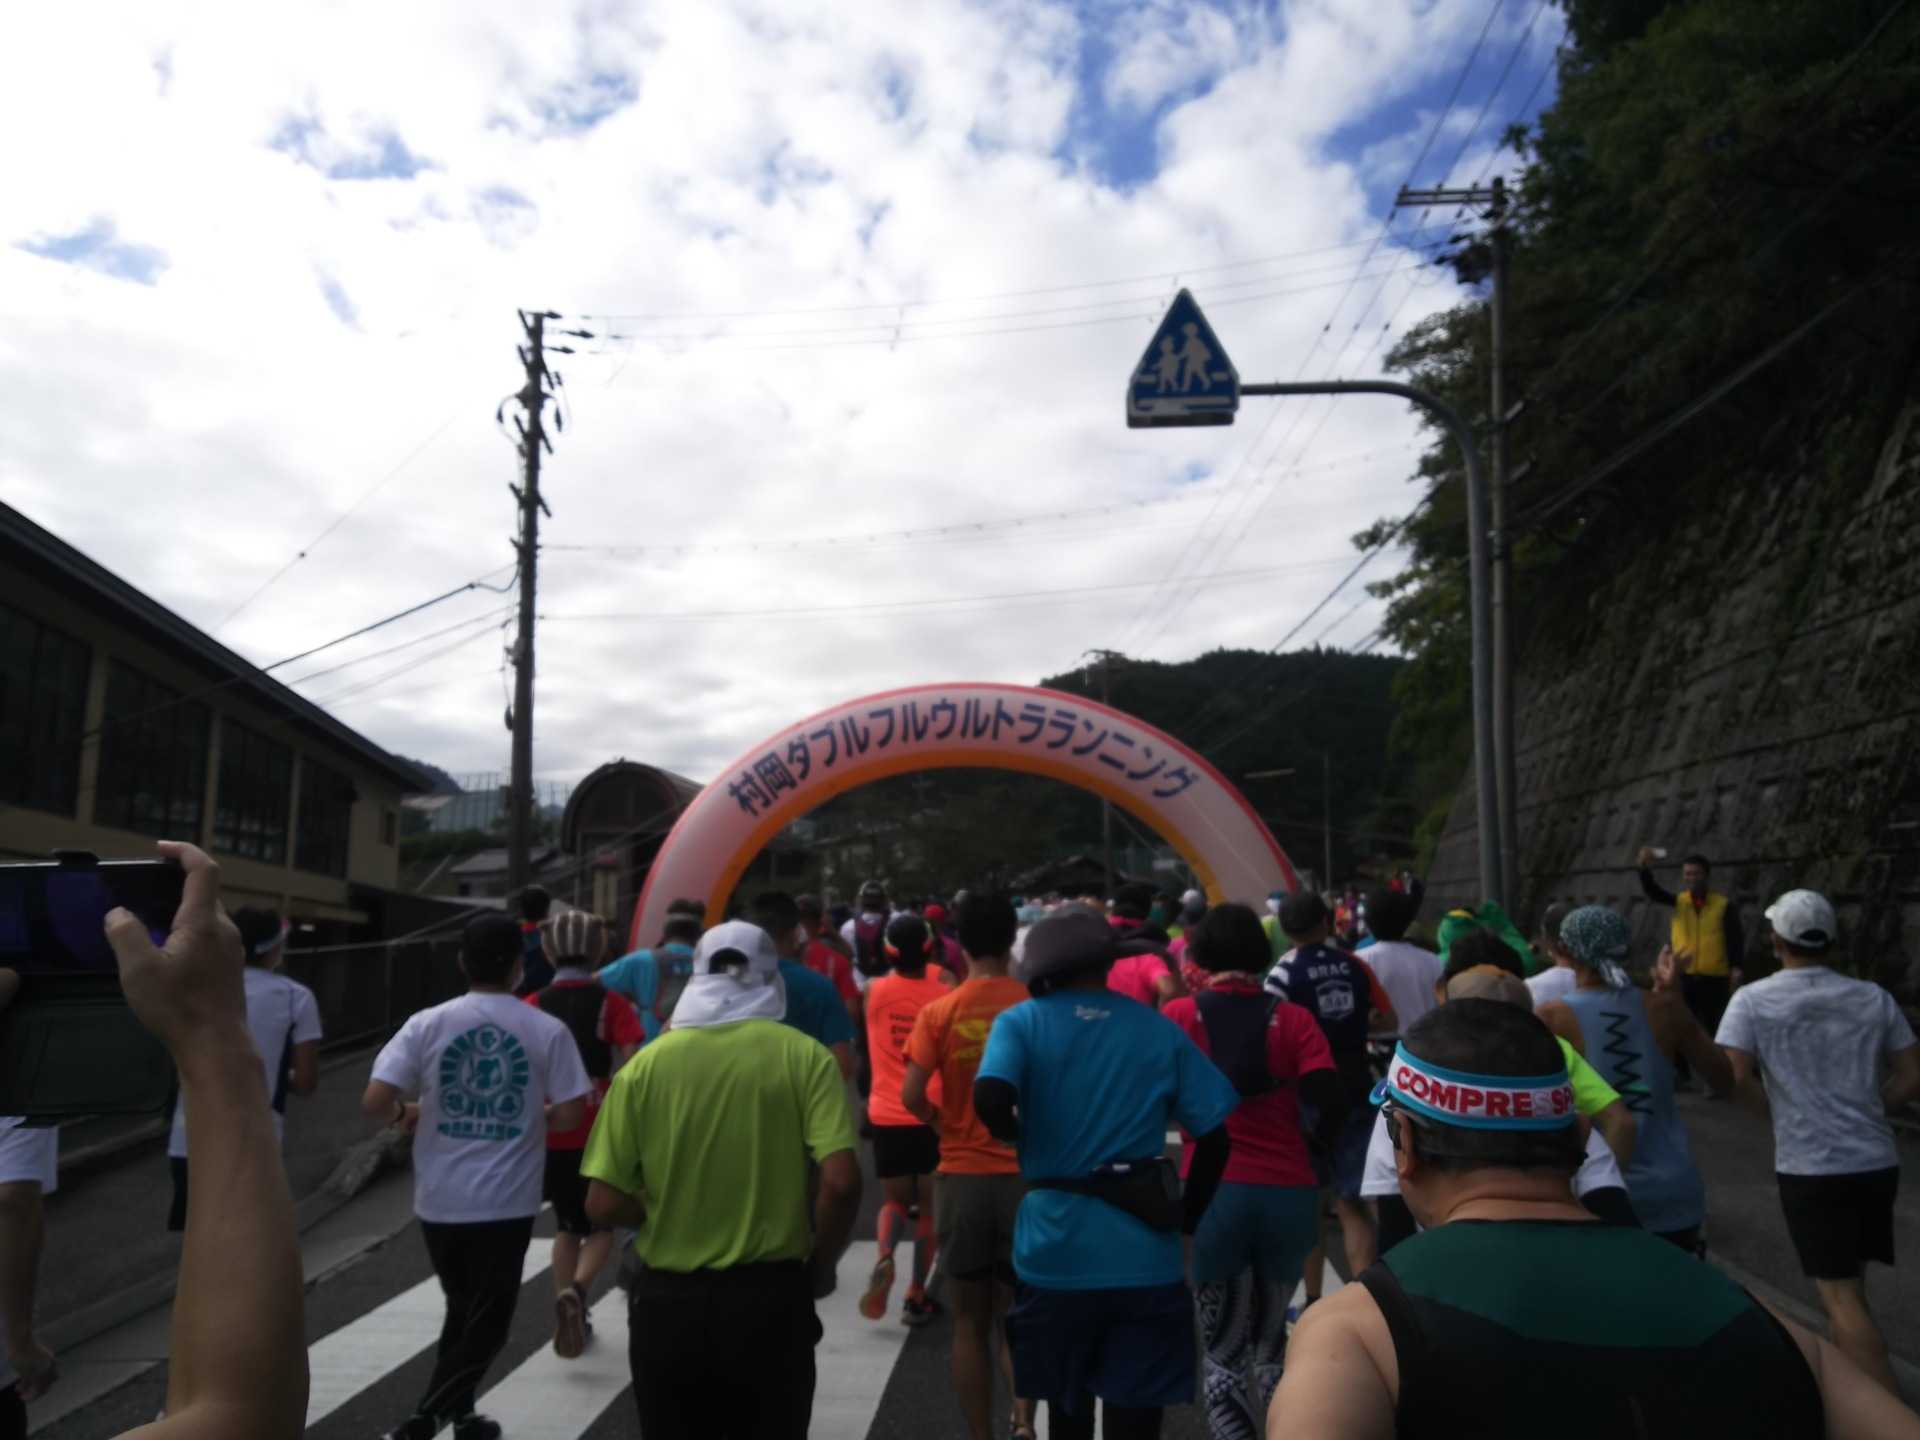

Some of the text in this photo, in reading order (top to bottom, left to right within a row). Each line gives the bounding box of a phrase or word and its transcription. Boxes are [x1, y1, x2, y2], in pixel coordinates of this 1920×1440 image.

[729, 698, 1197, 816] 村岡ダブルフルウルトラランニング
